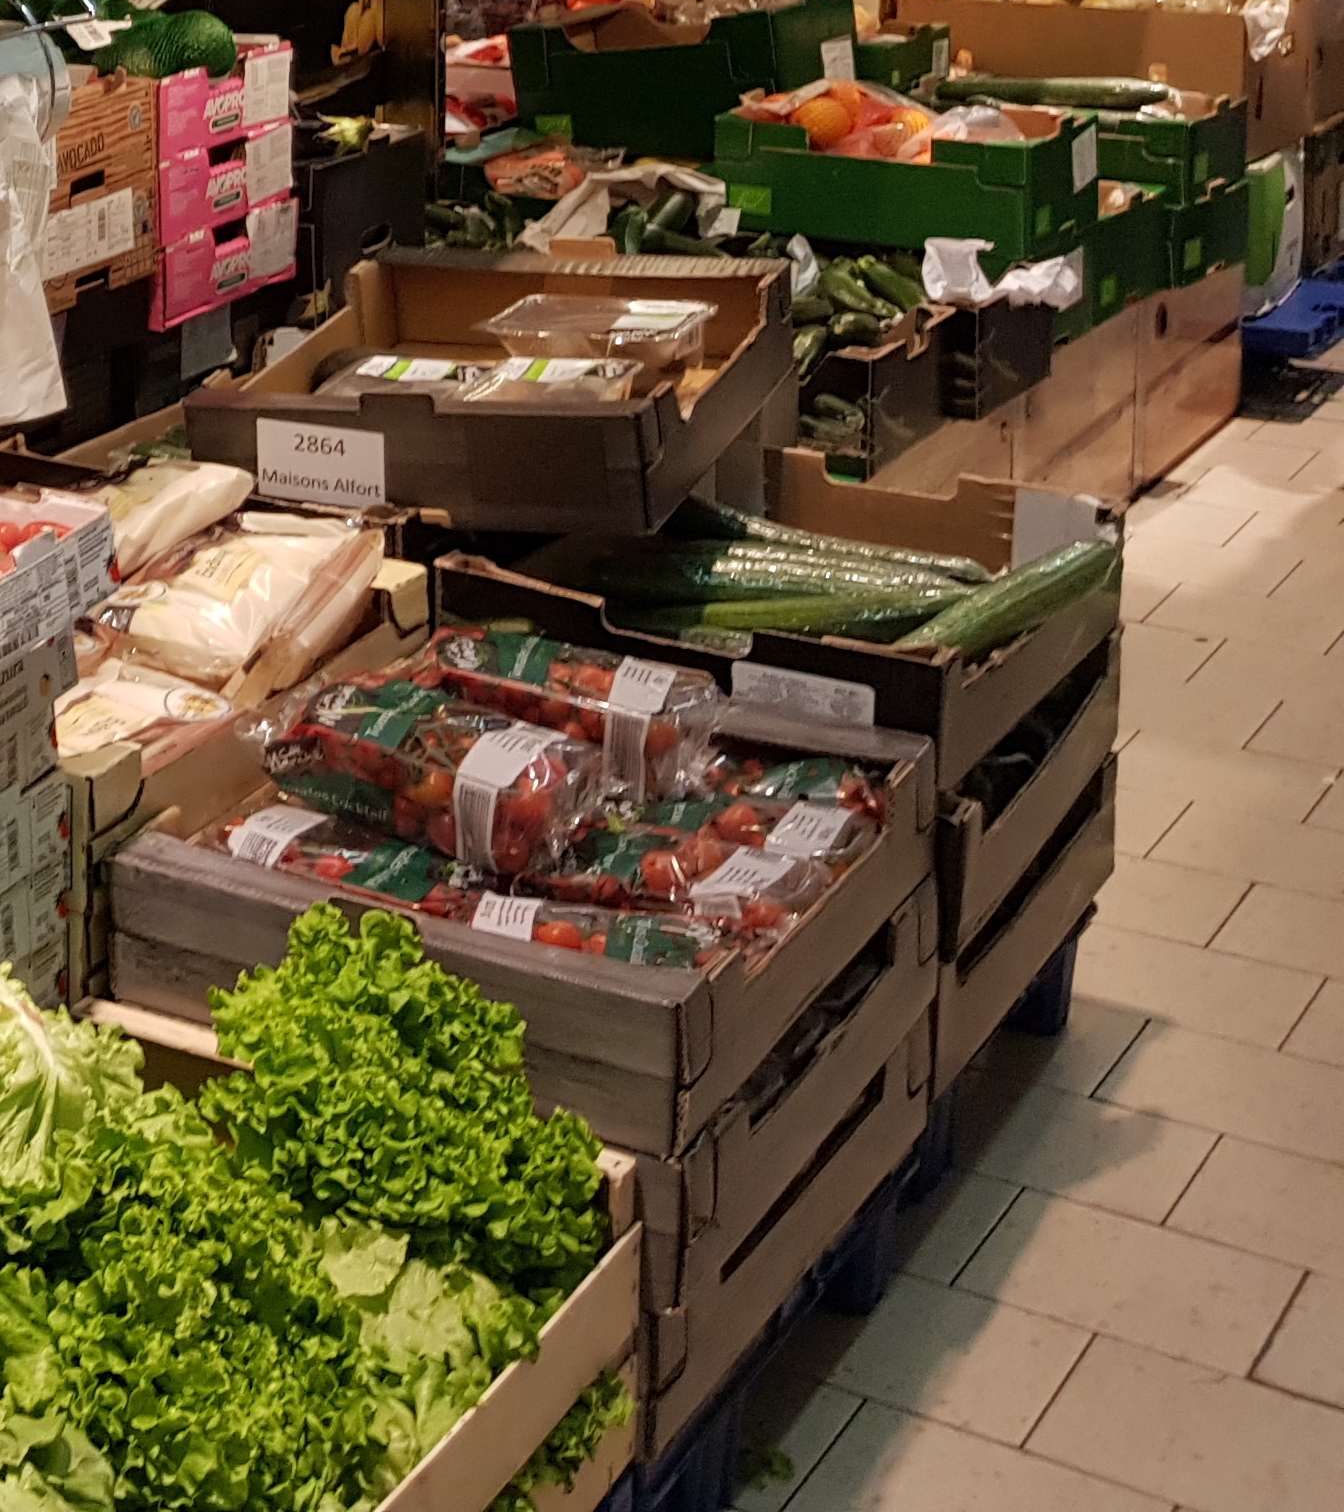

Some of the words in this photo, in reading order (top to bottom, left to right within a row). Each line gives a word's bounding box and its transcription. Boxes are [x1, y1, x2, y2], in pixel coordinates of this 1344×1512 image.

[292, 431, 347, 458] 2864
[260, 467, 325, 494] Maisons
[328, 467, 383, 499] Alfort
